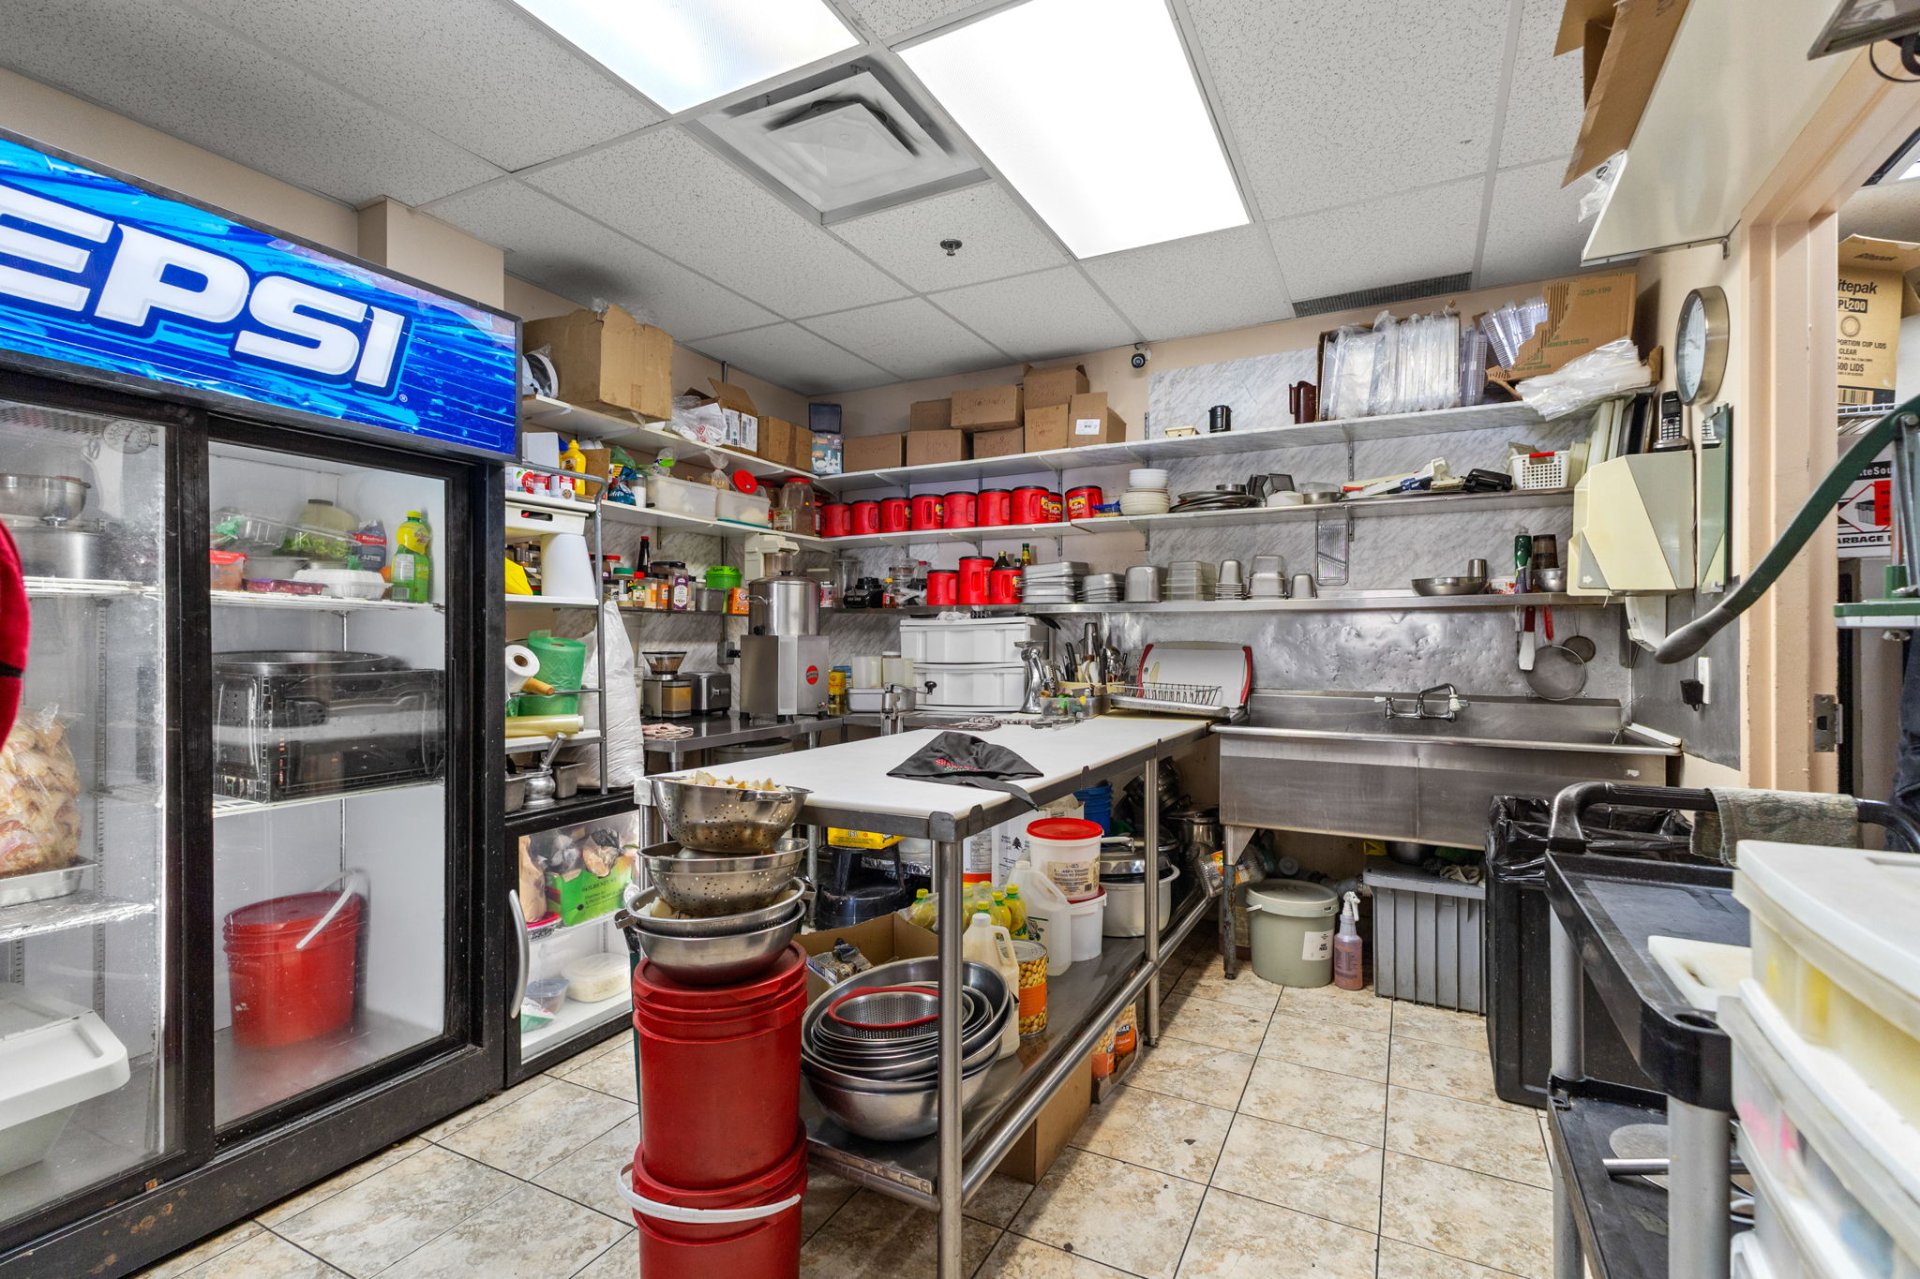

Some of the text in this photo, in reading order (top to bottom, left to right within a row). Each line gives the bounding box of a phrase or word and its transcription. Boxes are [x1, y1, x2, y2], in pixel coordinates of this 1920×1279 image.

[0, 186, 405, 389] EPSI
[1838, 279, 1878, 295] itepak
[1838, 299, 1866, 311] PL200
[1850, 363, 1864, 372] LIDS
